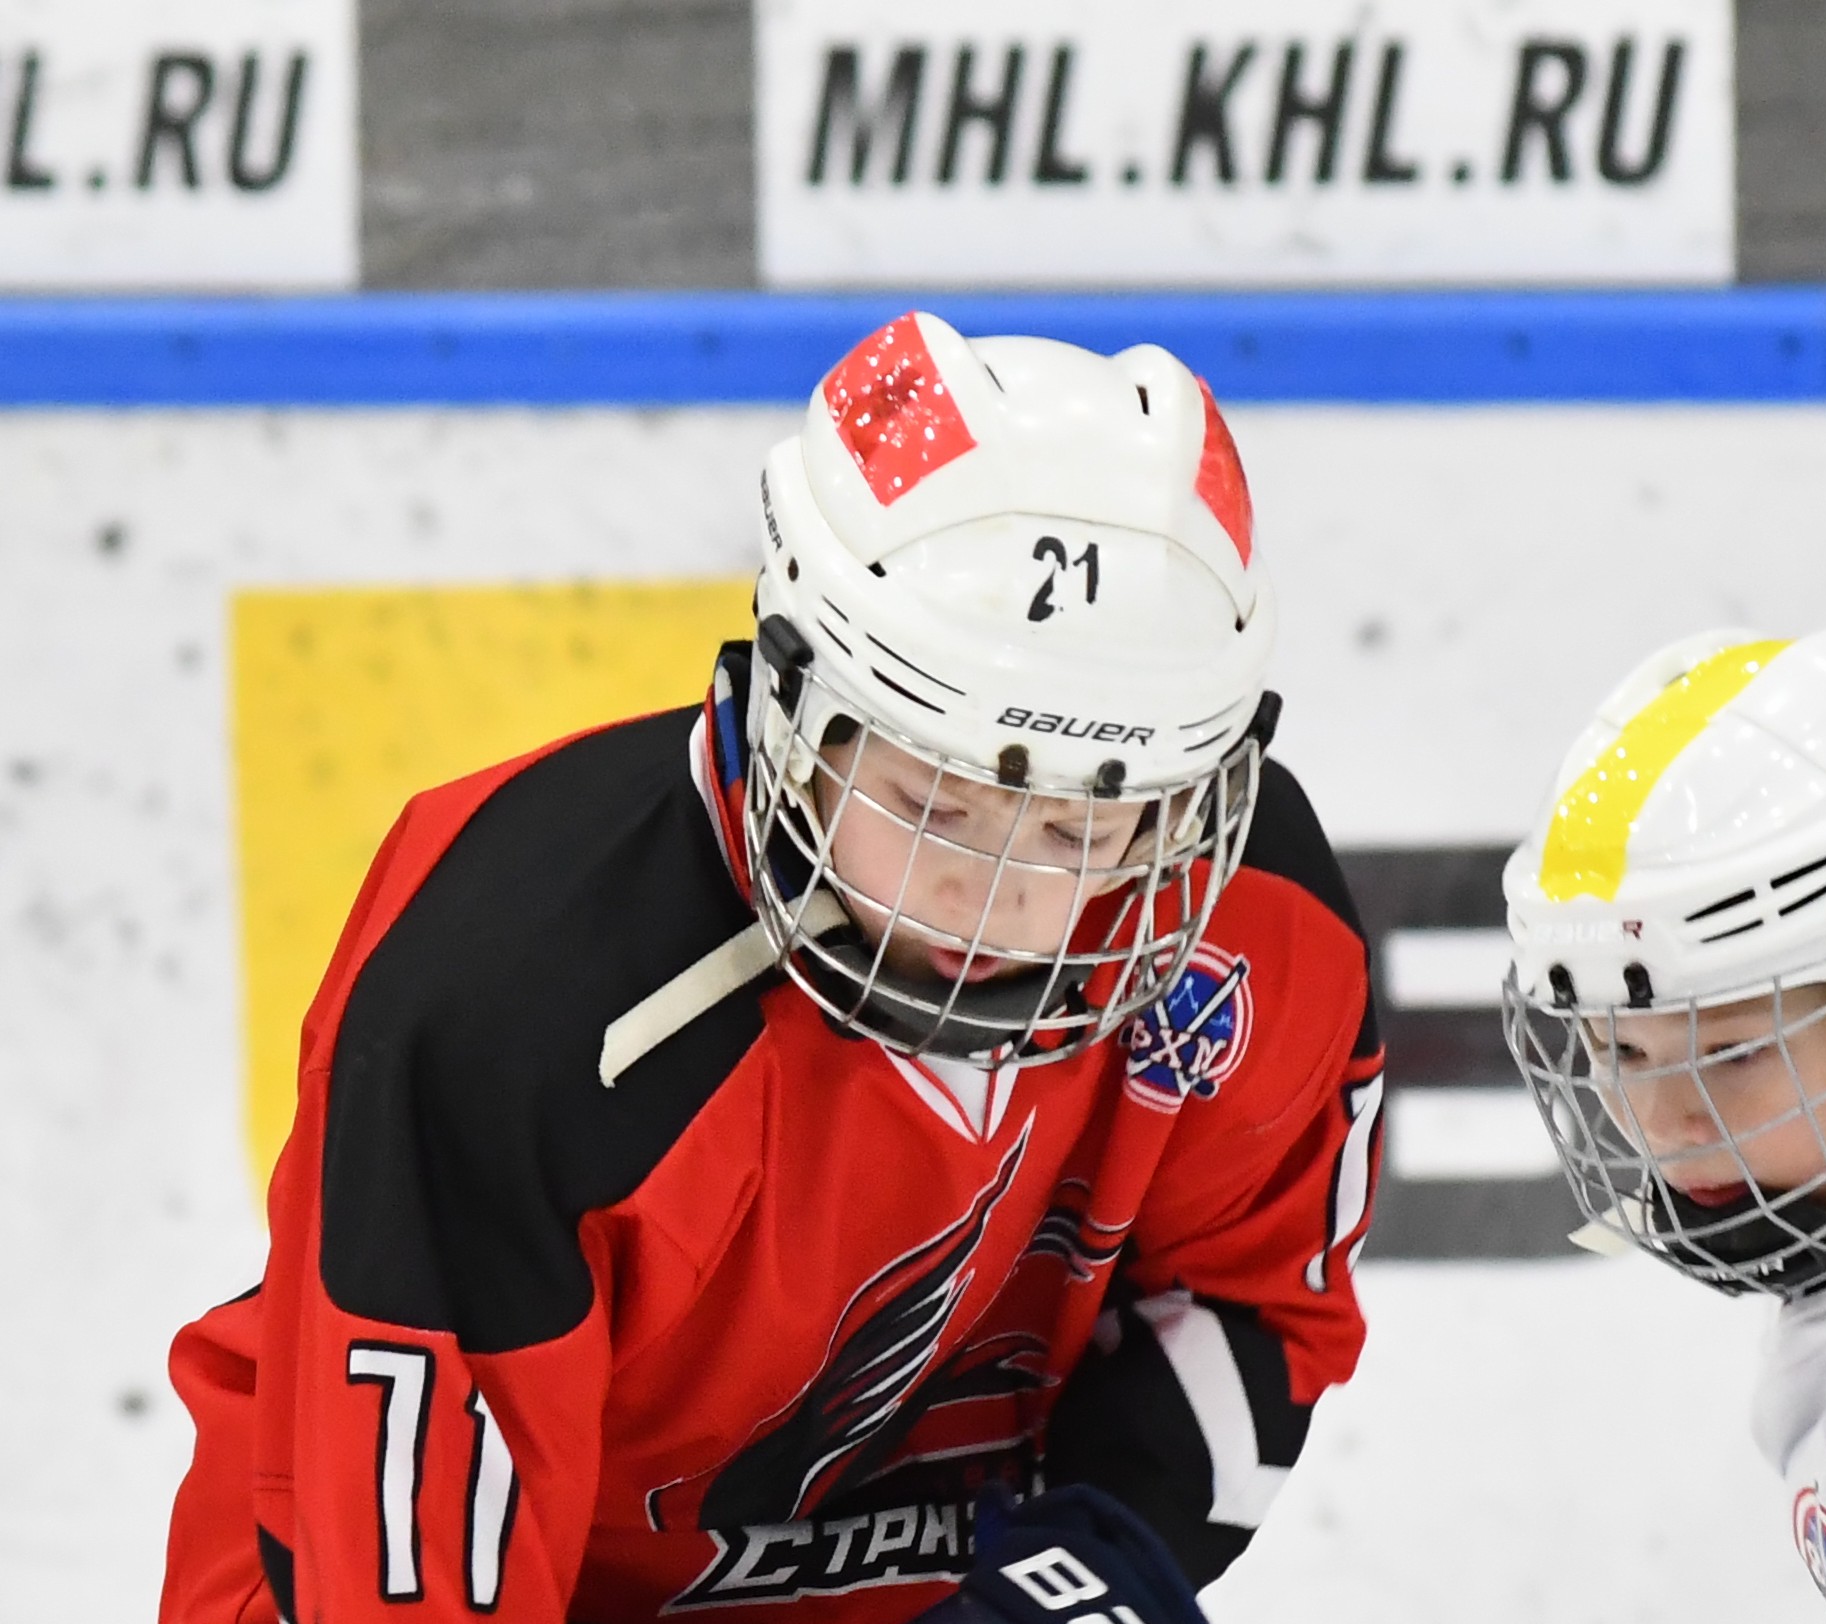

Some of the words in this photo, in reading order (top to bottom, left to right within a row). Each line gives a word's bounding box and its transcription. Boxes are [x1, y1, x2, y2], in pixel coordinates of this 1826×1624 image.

[5, 48, 309, 191] L.RU
[808, 40, 1686, 188] MHL.KHL.RU
[1026, 535, 1100, 622] 21
[996, 706, 1156, 747] BAUER
